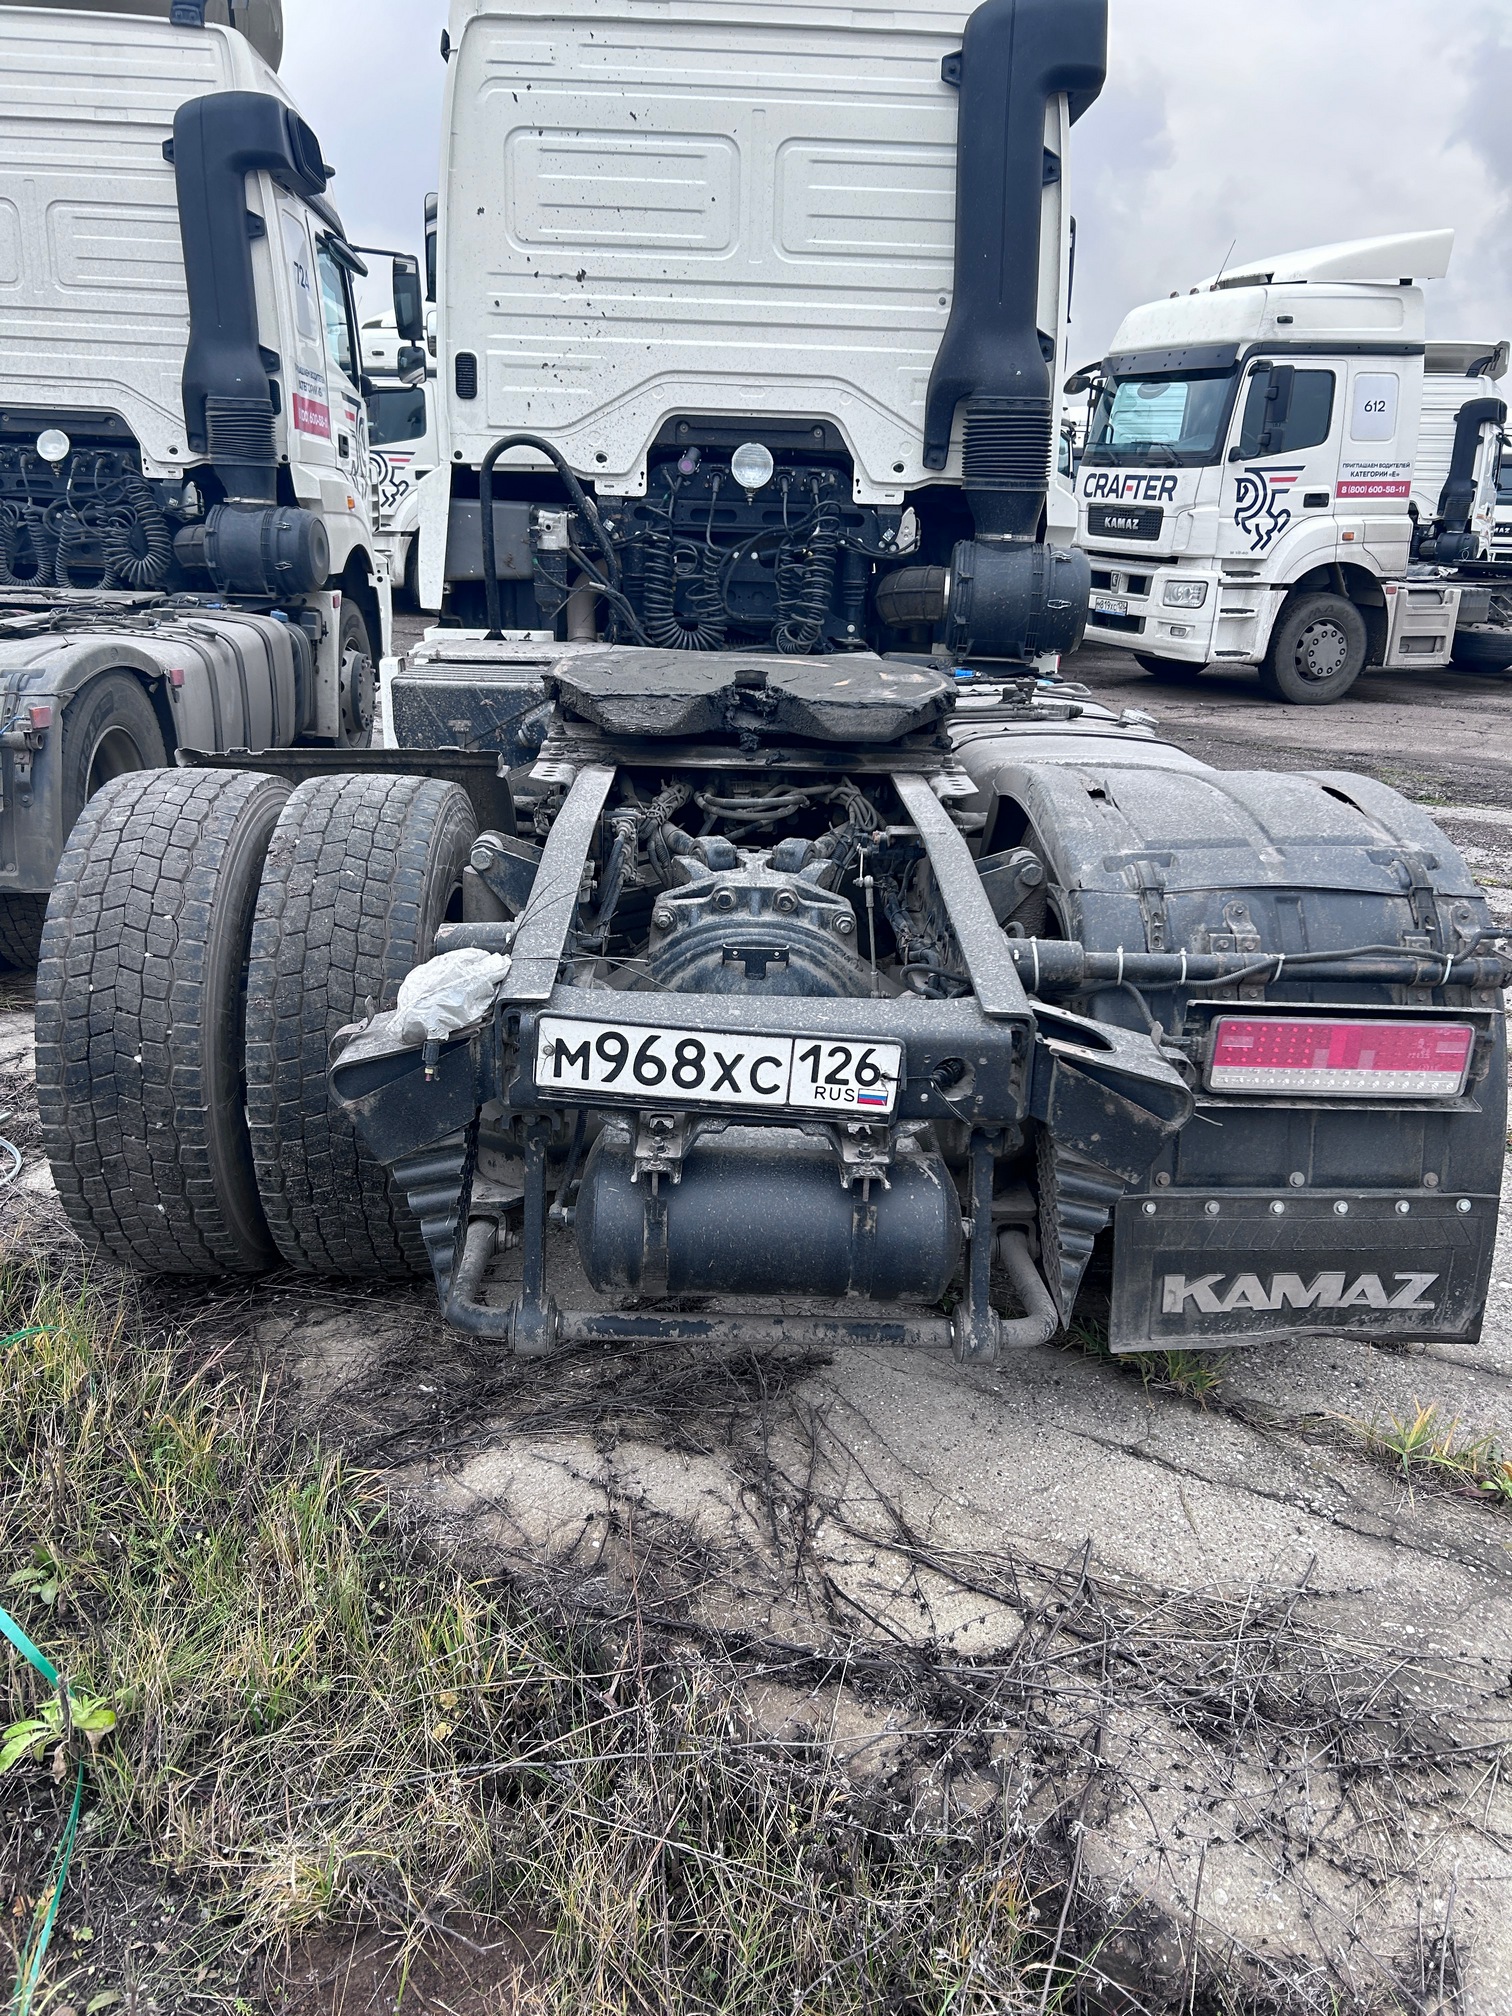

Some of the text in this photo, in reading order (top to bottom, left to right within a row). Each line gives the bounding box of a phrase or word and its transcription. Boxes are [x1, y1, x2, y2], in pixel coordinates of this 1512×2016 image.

[1364, 400, 1386, 412] 612
[1379, 461, 1410, 469] ВОДИТЕЛЕЙ
[1350, 470, 1388, 478] КАТЕГОРИИ
[1083, 473, 1178, 501] CRAFTER
[1341, 485, 1348, 494] 8
[1348, 485, 1367, 494] (800)
[1104, 516, 1140, 530] KAMAZ
[799, 1044, 881, 1087] 126
[814, 1086, 855, 1102] RUS
[1162, 1272, 1440, 1313] KAMAZ
